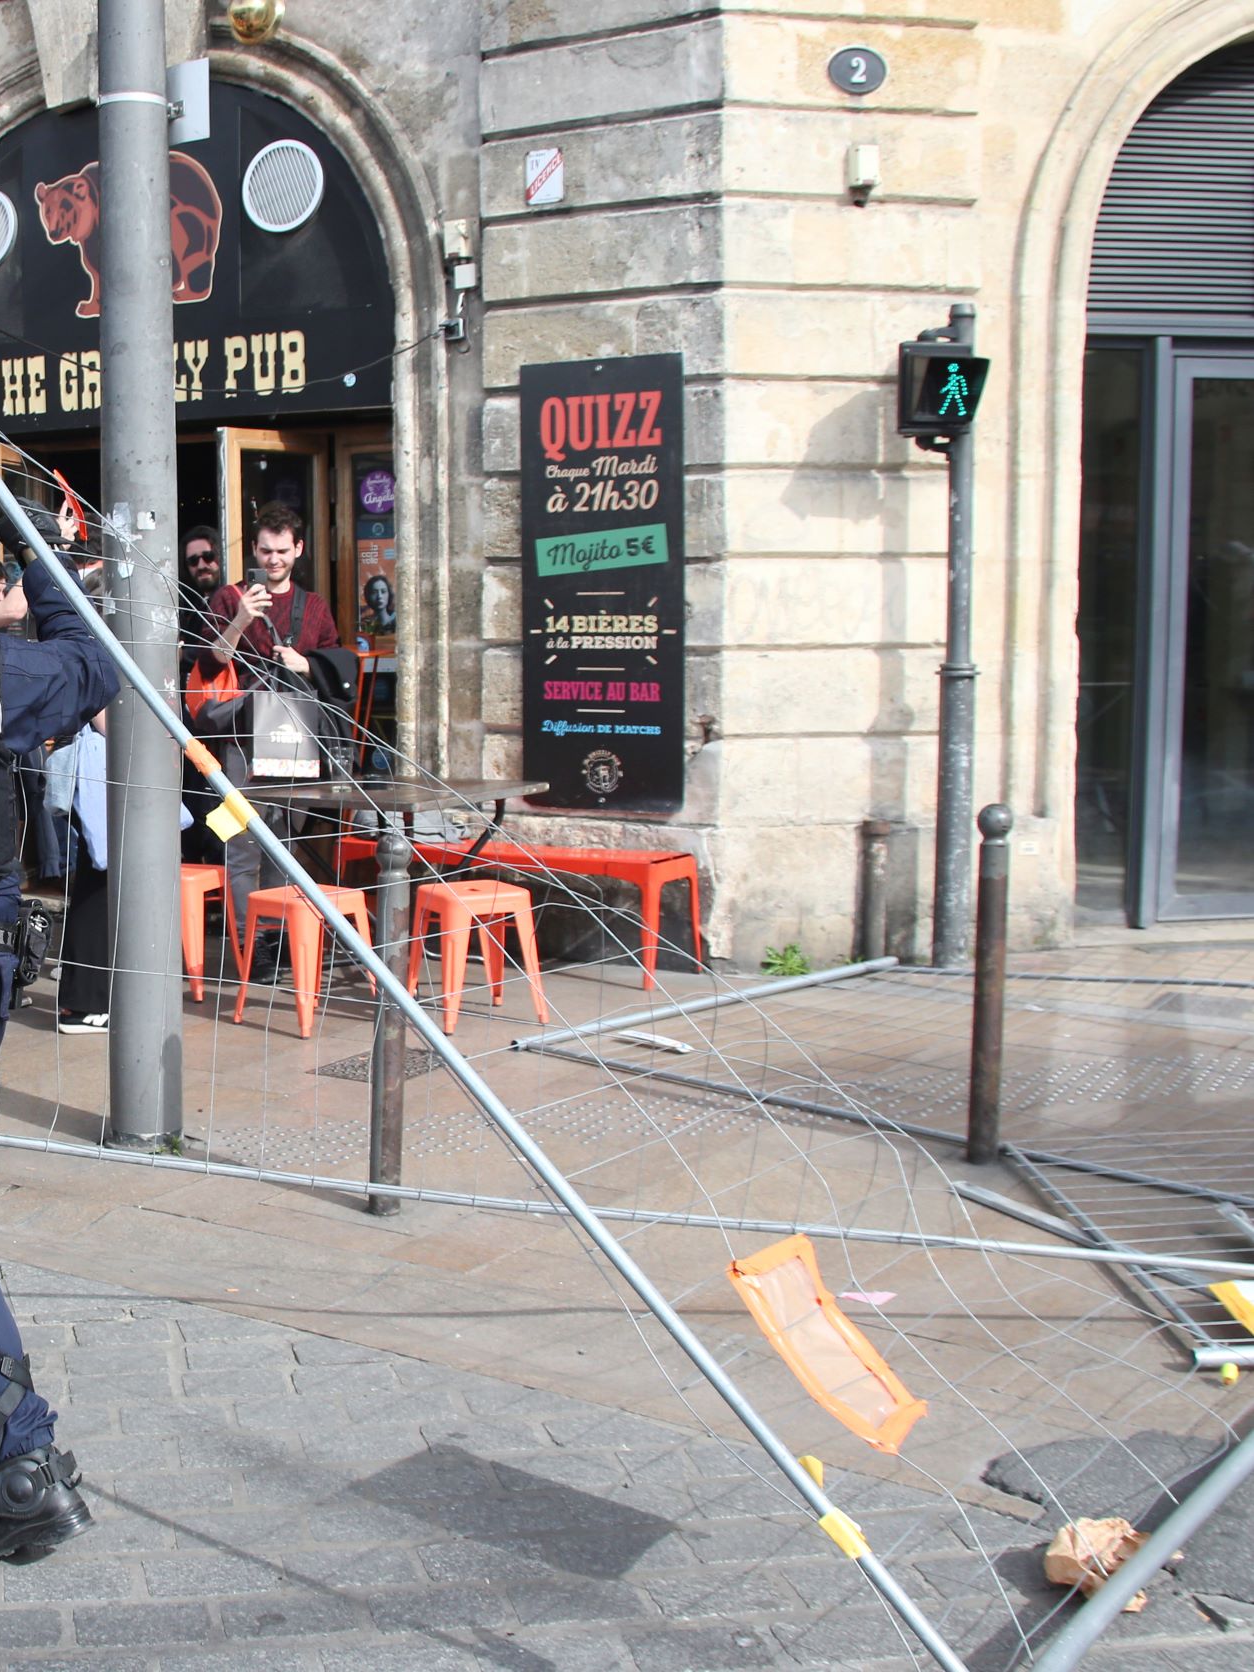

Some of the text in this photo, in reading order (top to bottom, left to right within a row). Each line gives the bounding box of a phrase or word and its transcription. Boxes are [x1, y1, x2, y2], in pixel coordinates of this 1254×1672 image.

[850, 56, 867, 83] 2
[224, 330, 306, 398] PUB
[540, 390, 662, 462] QUIZZ
[546, 454, 658, 482] Chaque Mardi
[546, 479, 660, 513] à 21h30
[547, 535, 656, 571] Mojito 5€
[546, 609, 659, 633] 14 BIÈRES
[557, 636, 570, 649] la
[570, 635, 659, 650] PRESSION
[543, 680, 661, 702] SERVICE AU BAR
[541, 719, 661, 736] Diffusion DE MATCHS
